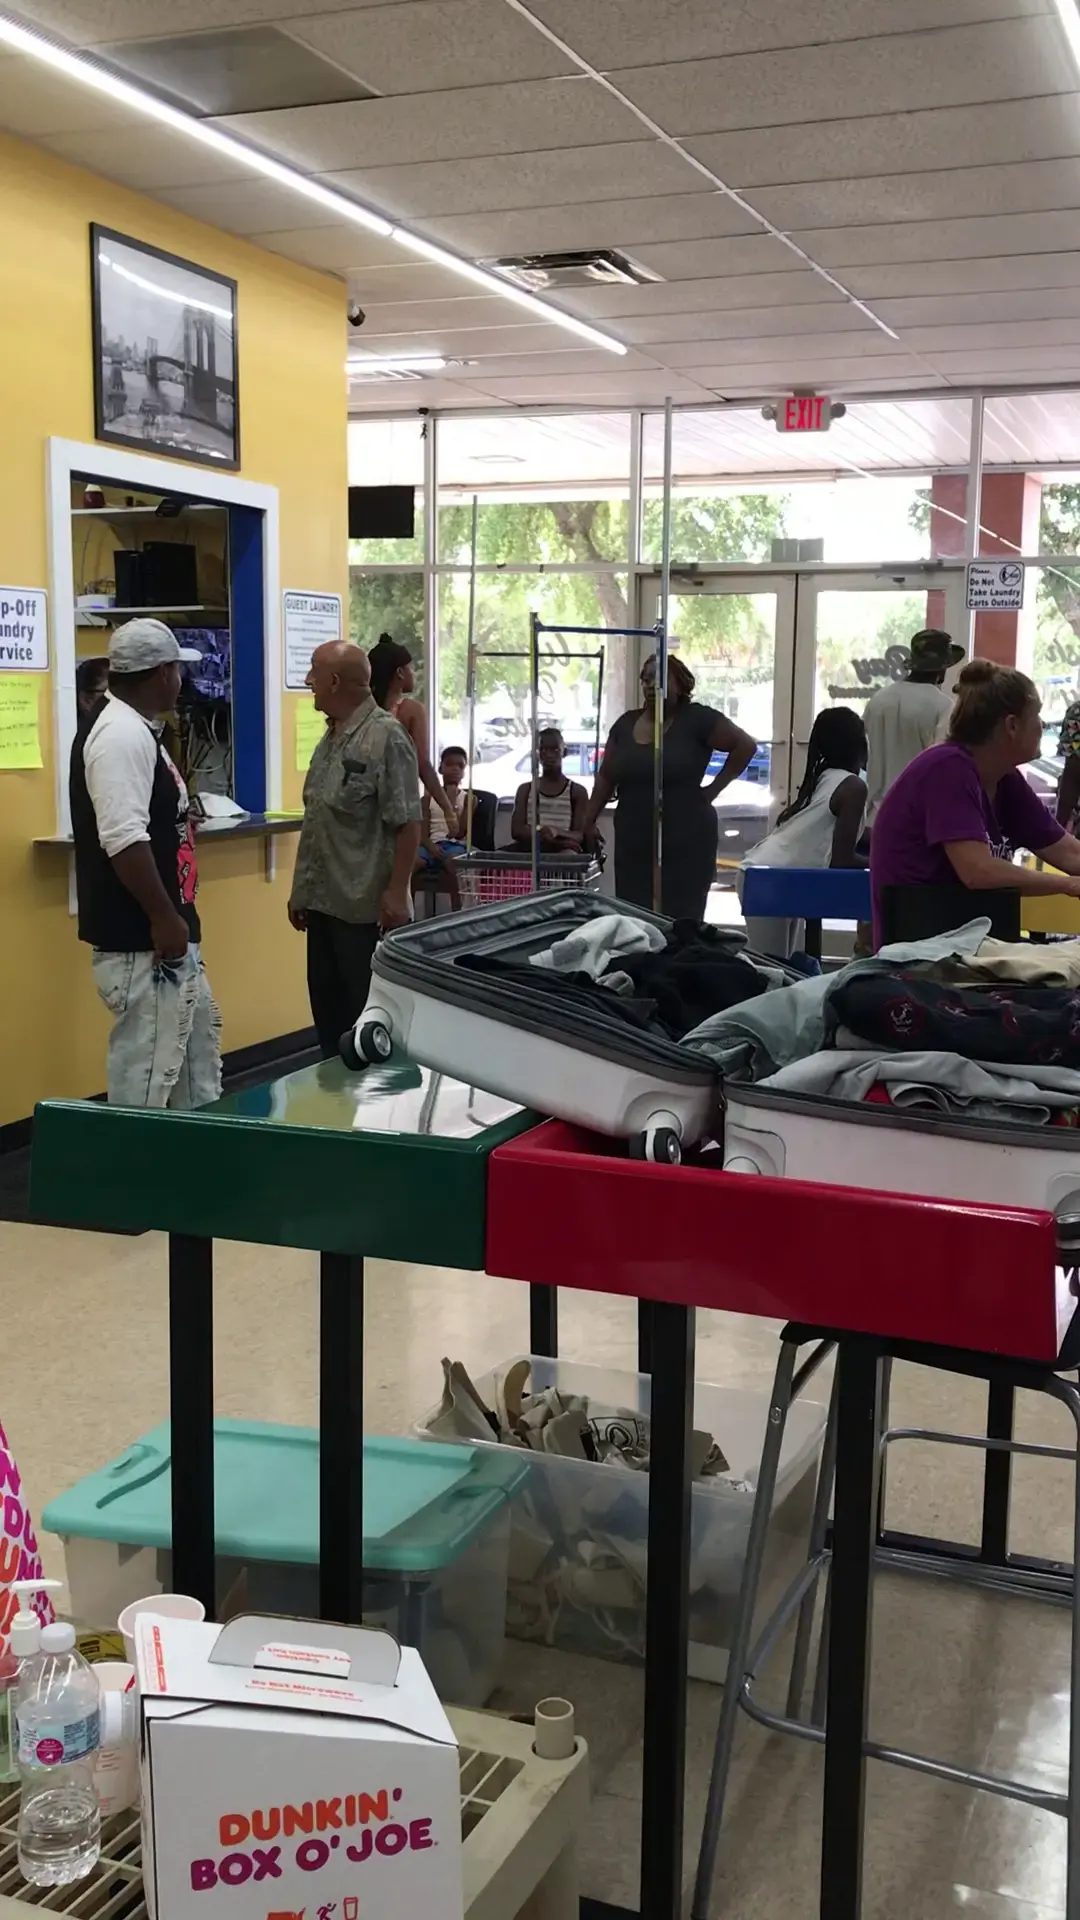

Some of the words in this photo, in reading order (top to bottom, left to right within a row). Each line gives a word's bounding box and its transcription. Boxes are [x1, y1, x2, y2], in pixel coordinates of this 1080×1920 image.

[785, 398, 825, 430] EXIT
[969, 578, 980, 586] Do
[981, 578, 995, 586] Not
[969, 588, 987, 596] Take
[990, 588, 1020, 598] Laundry
[1, 598, 36, 619] p-Off
[286, 598, 308, 611] GUEST
[310, 600, 338, 613] LAUNDRY
[968, 599, 989, 607] Carts
[991, 598, 1020, 607] Outside
[219, 1787, 403, 1846] DUNKIN'
[190, 1846, 283, 1891] BOX
